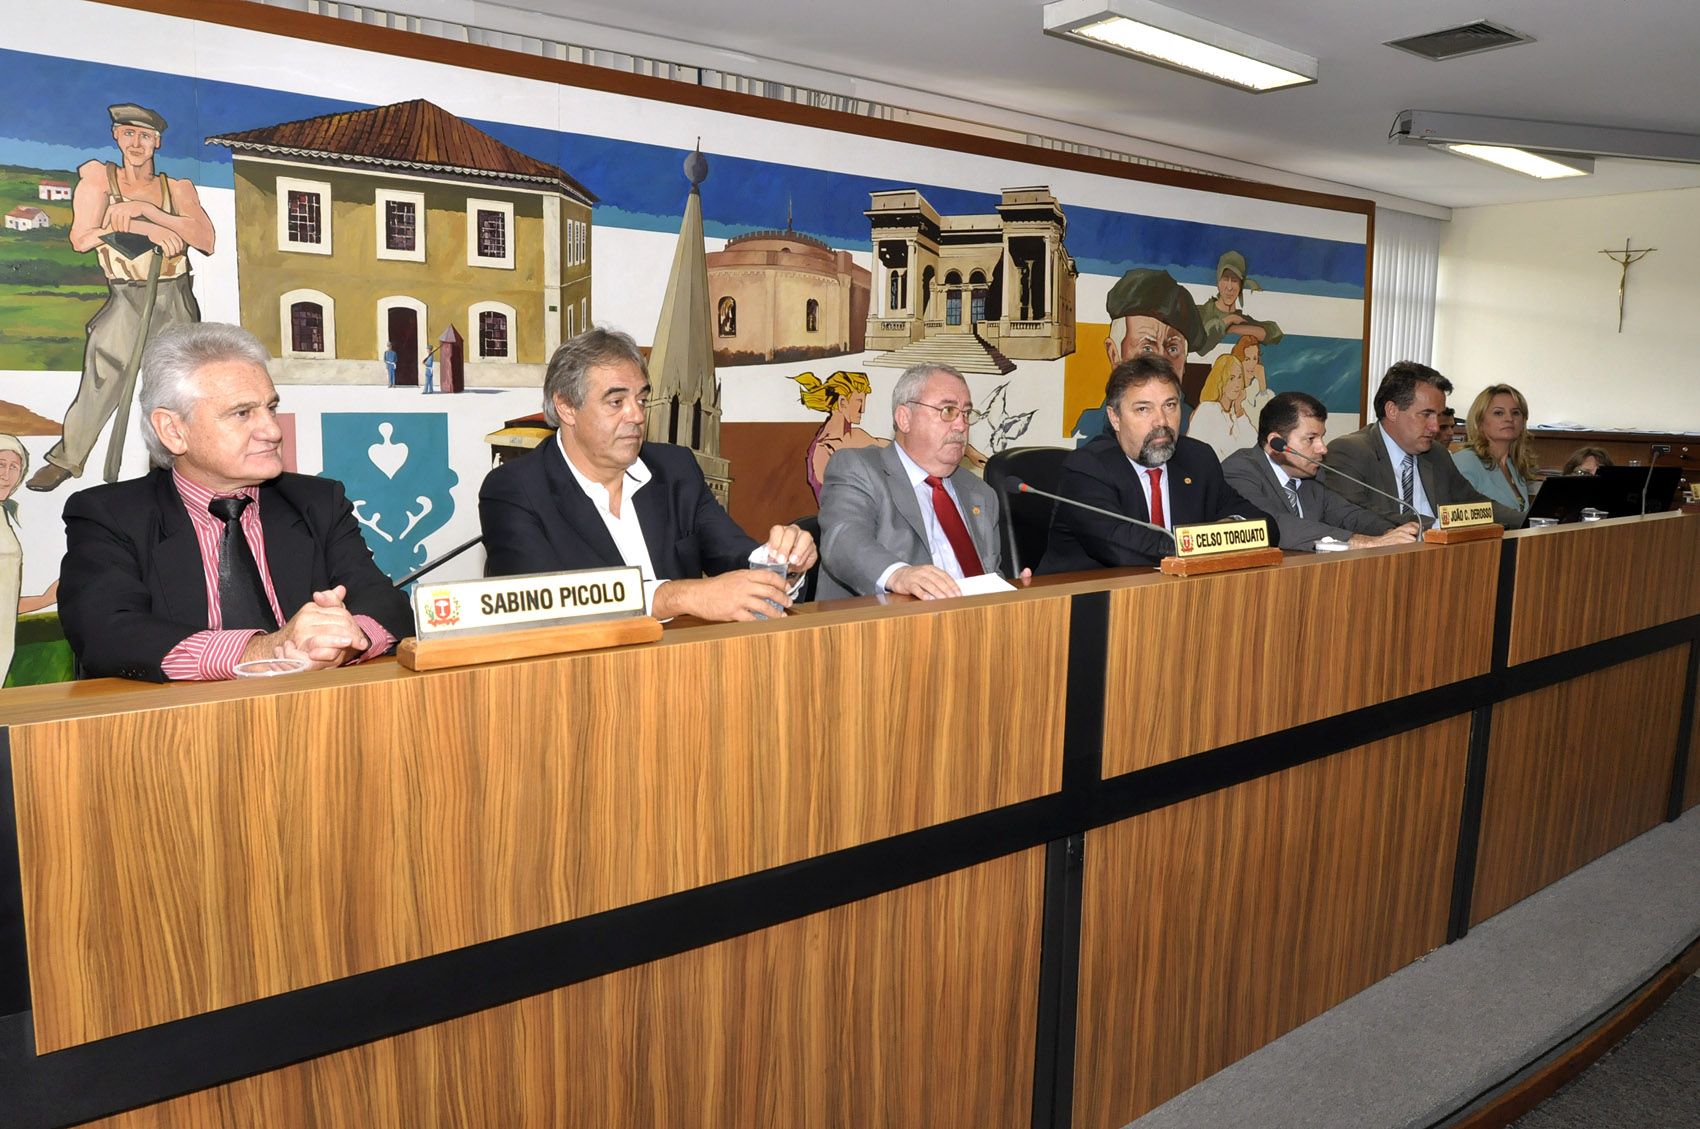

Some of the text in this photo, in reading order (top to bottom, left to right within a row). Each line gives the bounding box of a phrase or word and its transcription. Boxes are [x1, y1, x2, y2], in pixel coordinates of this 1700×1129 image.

[1451, 508, 1463, 522] JOÃO
[1470, 507, 1492, 520] DEROSSO
[1196, 527, 1265, 548] CELSO TORQUATO
[480, 581, 625, 615] SABINO PICOLO
